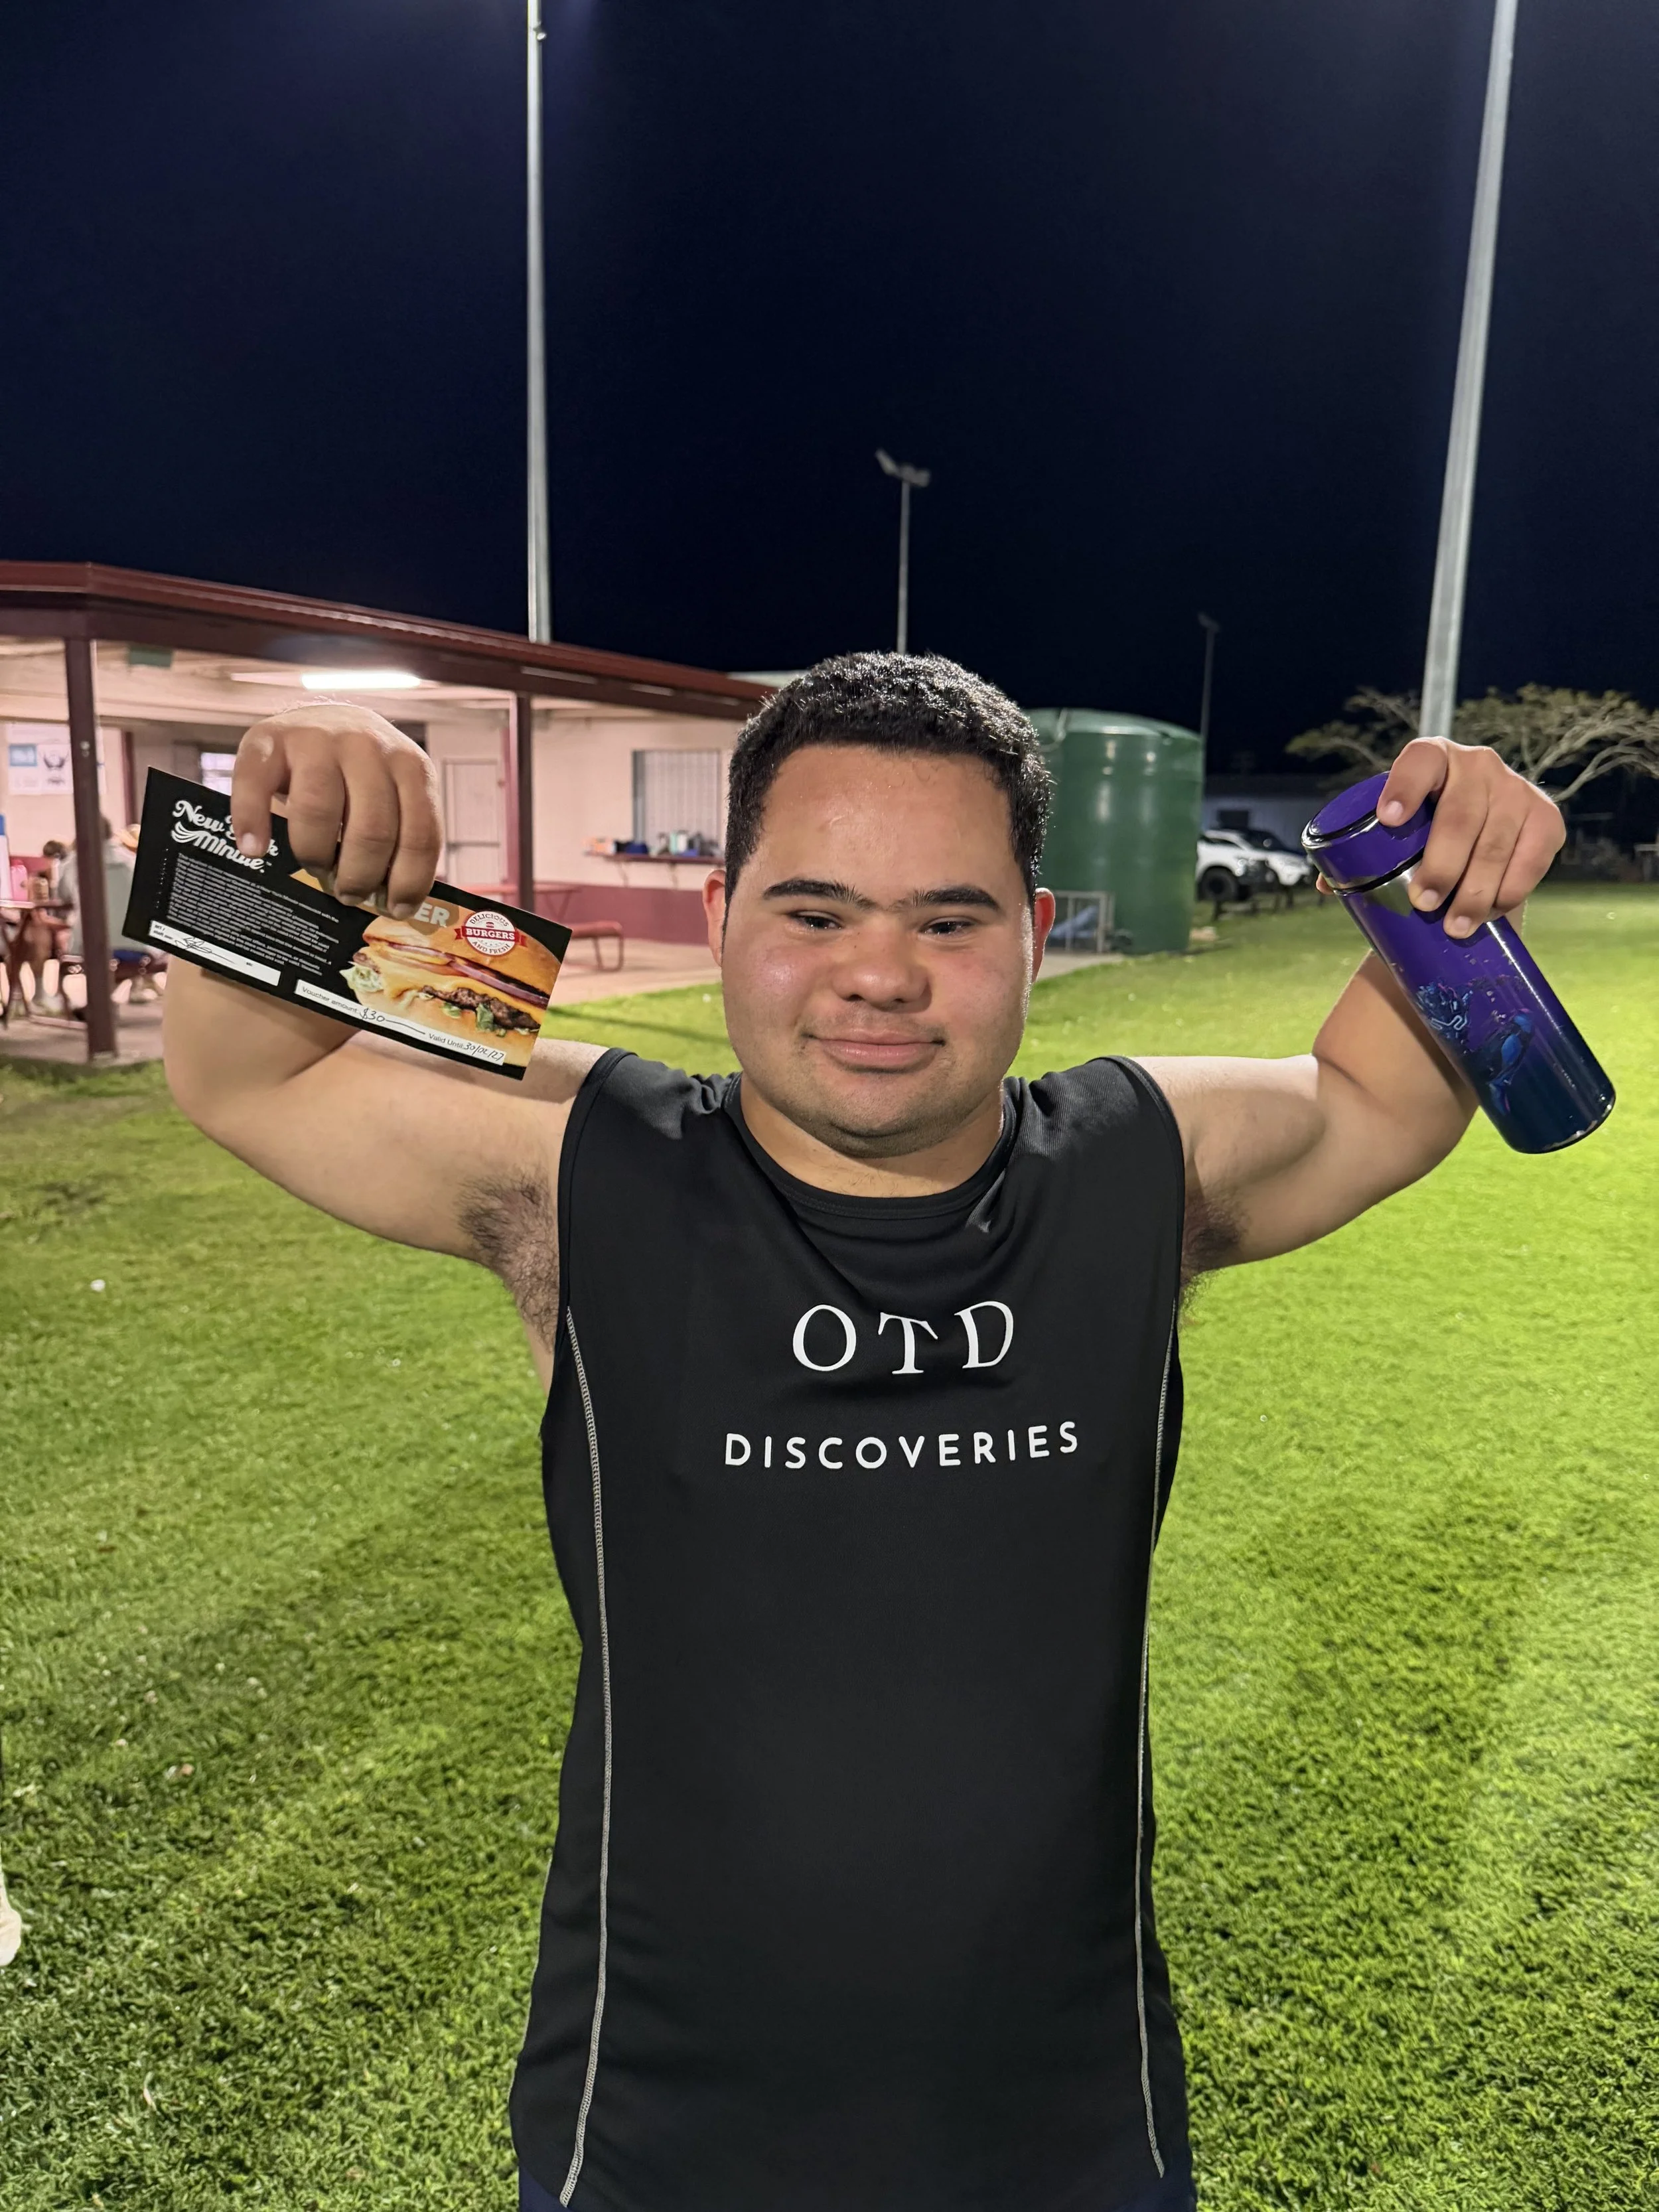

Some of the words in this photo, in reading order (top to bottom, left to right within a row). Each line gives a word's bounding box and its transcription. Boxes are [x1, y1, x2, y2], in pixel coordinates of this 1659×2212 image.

[173, 800, 225, 832] New
[469, 913, 509, 926] DELICIOUS
[466, 928, 515, 940] BURGERS
[472, 941, 488, 952] AND
[488, 944, 510, 954] FRESH
[303, 986, 330, 1002] Voucher
[359, 1007, 385, 1022] $30
[429, 1033, 446, 1043] Valid
[792, 1301, 1014, 1374] OTD
[725, 1421, 1078, 1469] DISCOVERIES
